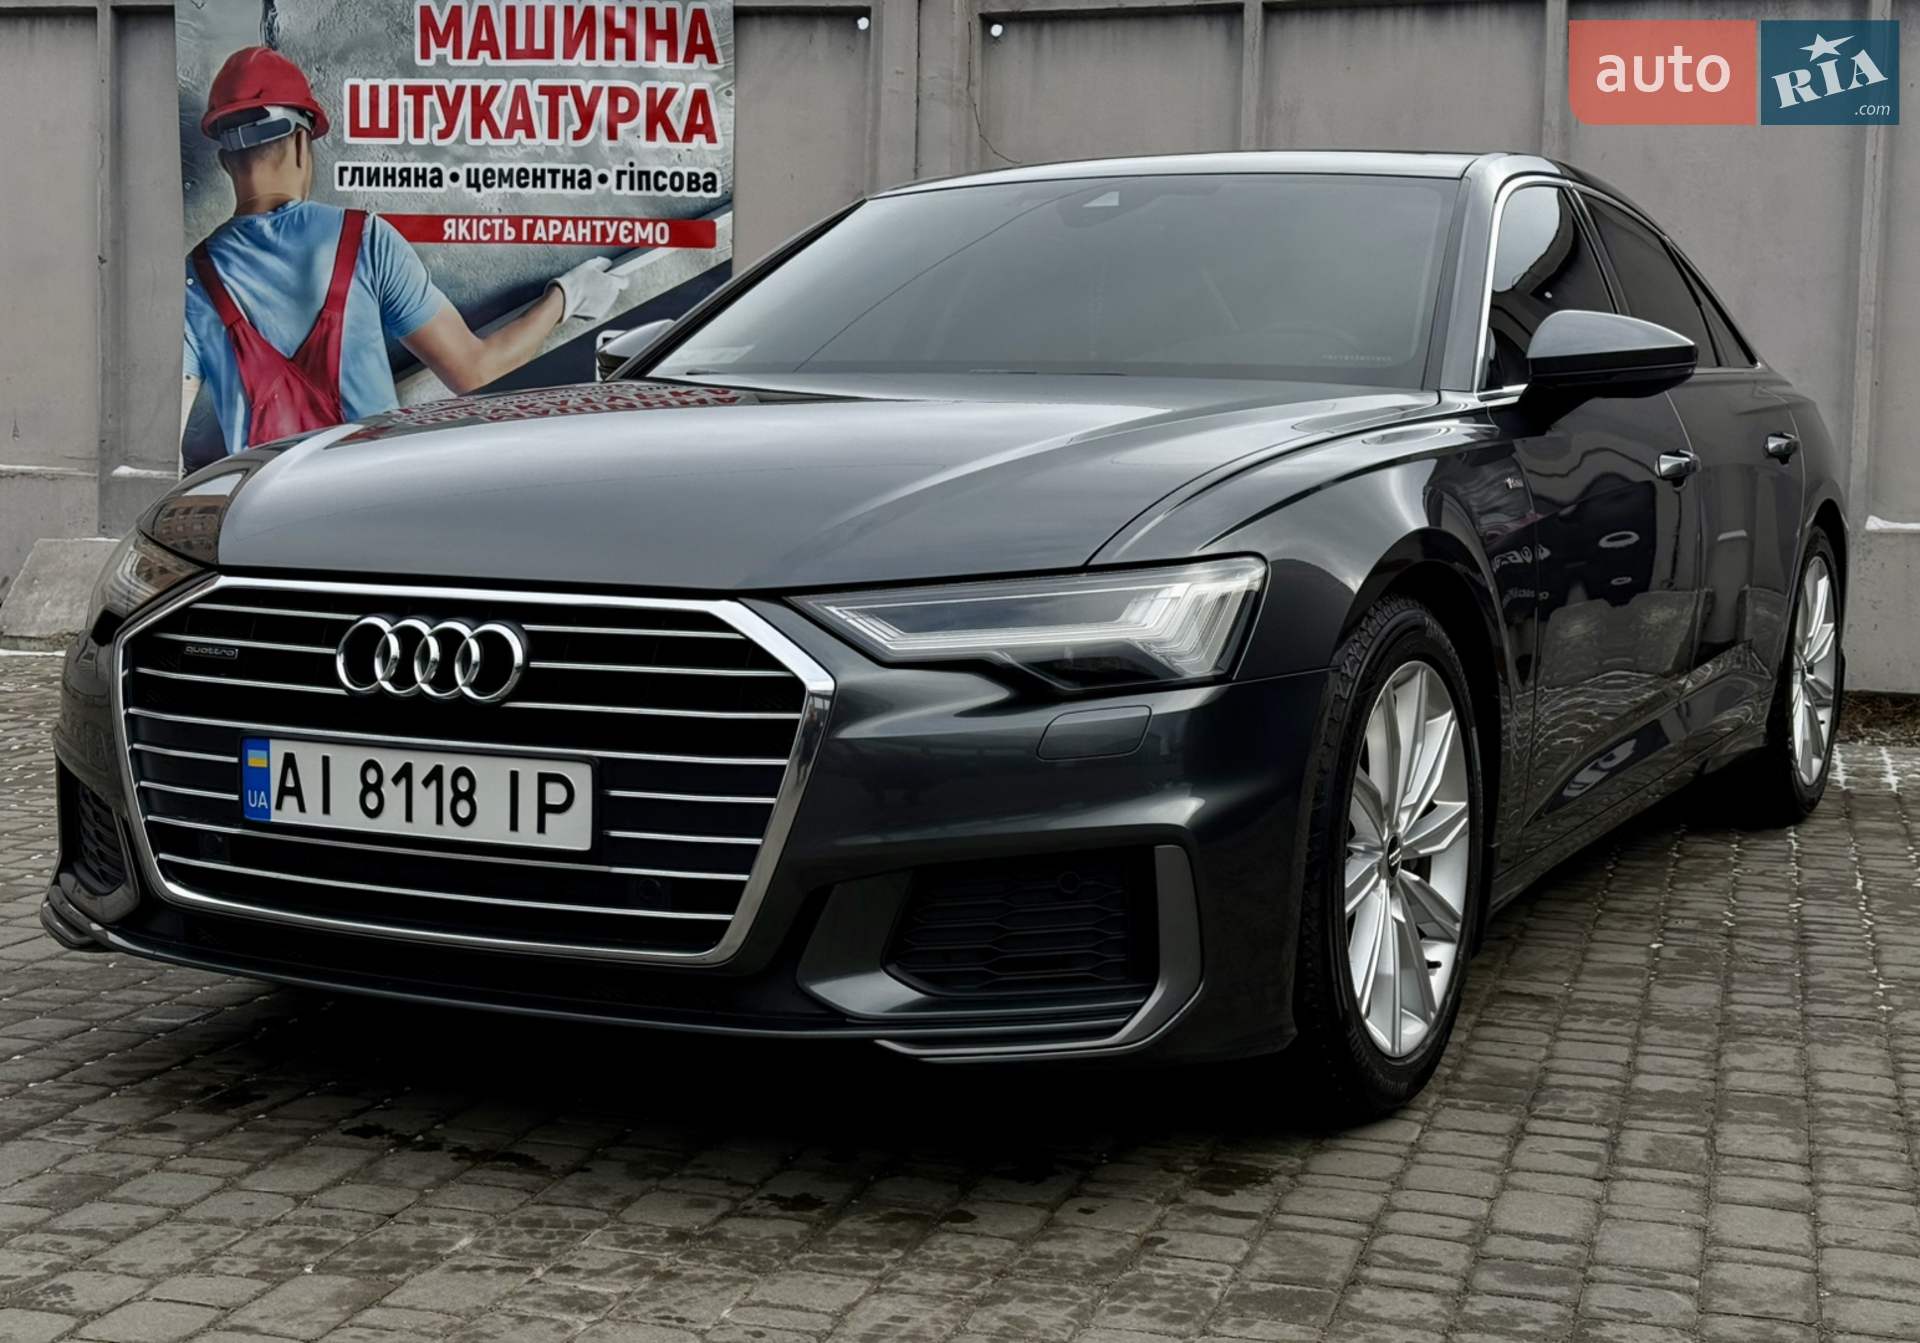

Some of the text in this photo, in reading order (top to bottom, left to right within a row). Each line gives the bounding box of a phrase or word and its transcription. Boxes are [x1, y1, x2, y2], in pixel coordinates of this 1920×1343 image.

[420, 4, 720, 65] МАШИННА
[349, 83, 719, 145] ШТУКАТУРКА
[337, 161, 719, 194] глиняна цементна гіпсова
[442, 218, 670, 246] ЯКІСТЬ ГАРАНТУЄМО
[184, 645, 236, 657] quattro
[248, 790, 269, 809] UA
[274, 751, 576, 834] AI 8118 IP
